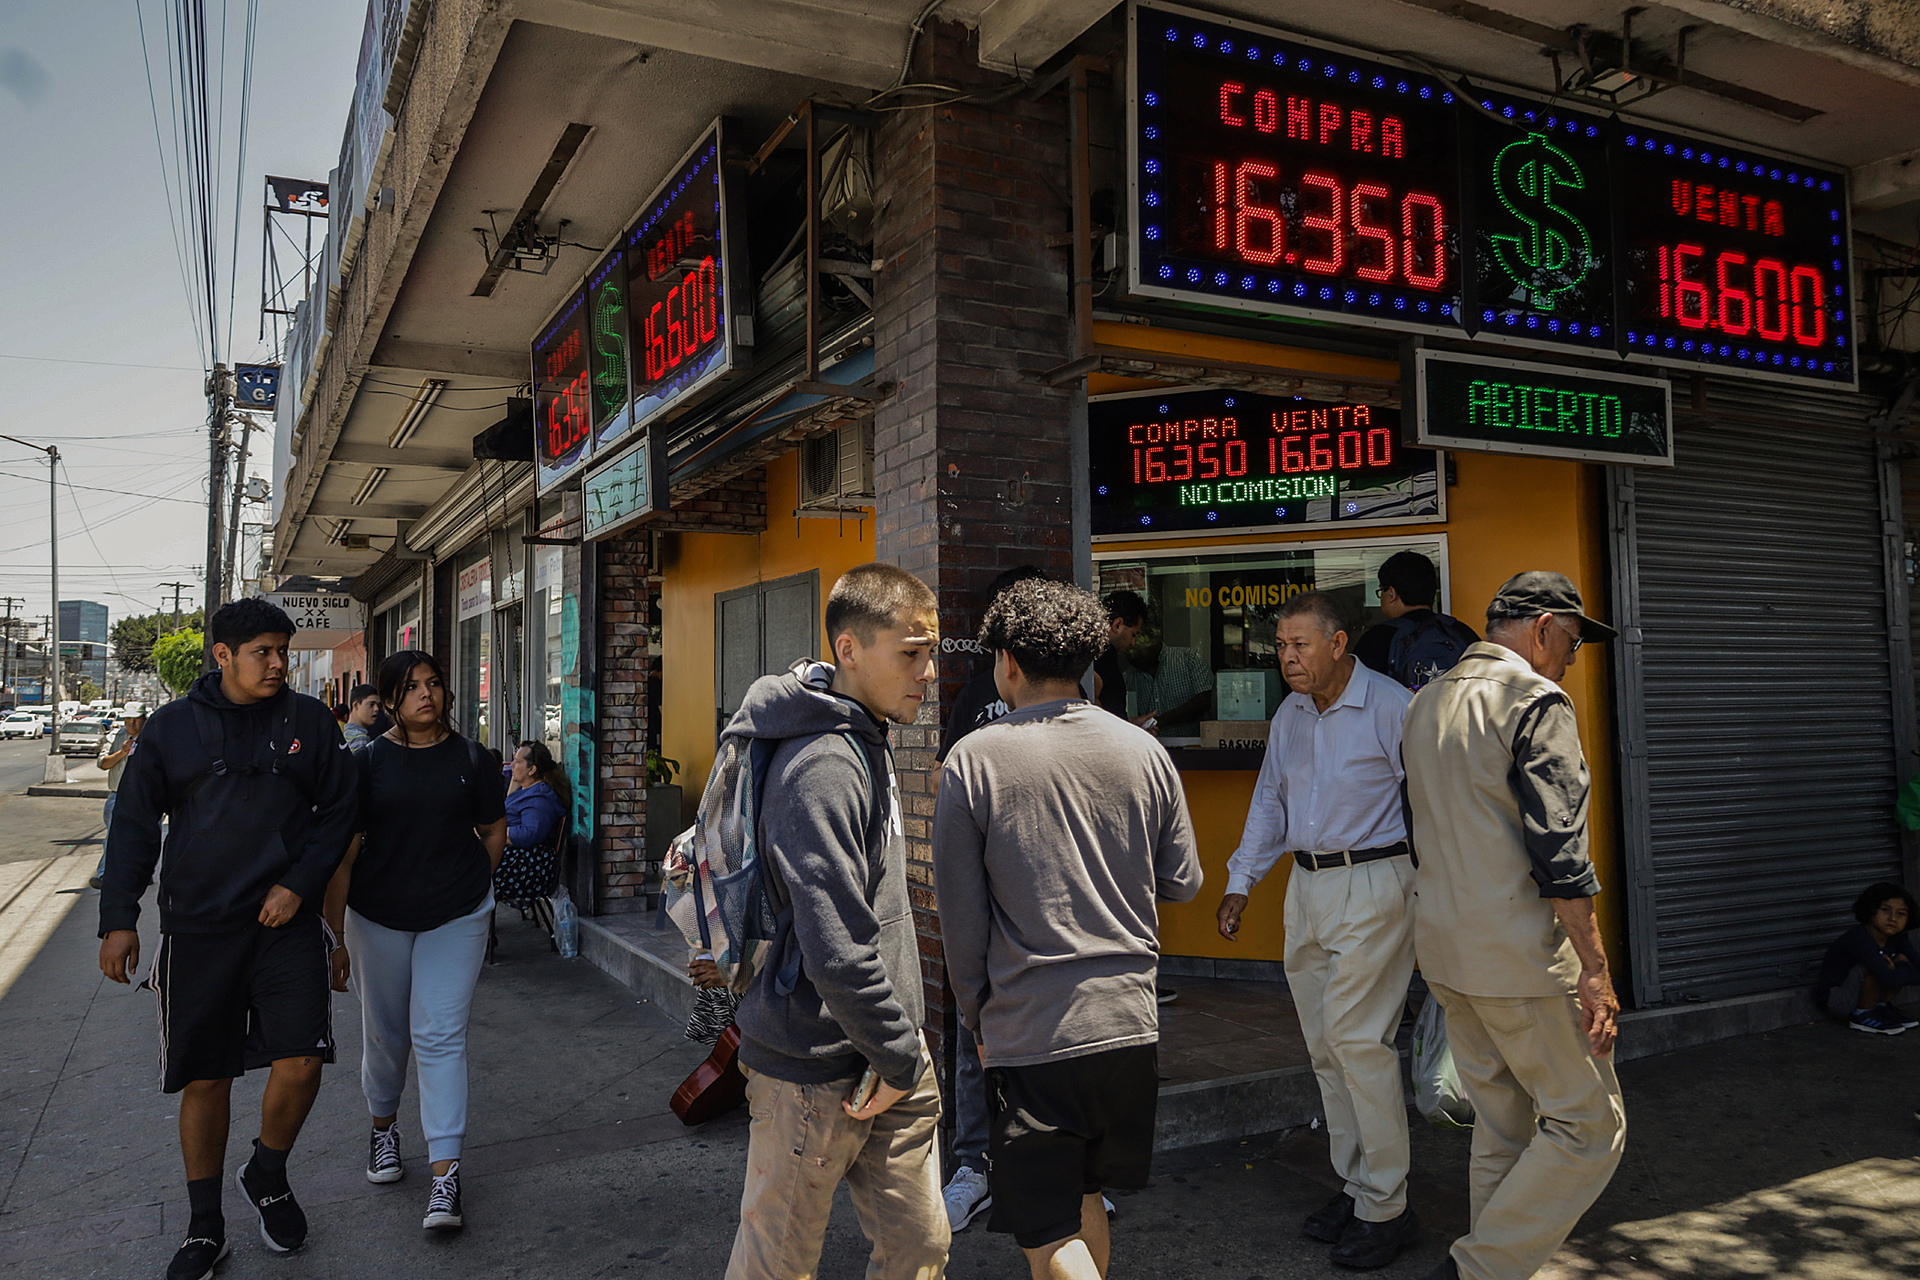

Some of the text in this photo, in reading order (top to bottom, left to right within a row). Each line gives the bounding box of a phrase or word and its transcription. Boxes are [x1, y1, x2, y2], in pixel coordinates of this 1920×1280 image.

[1220, 81, 1402, 158] COMPRA
[1215, 161, 1444, 288] 16.350
[1671, 178, 1784, 236] VENTA
[1658, 243, 1825, 347] 16.600
[1128, 404, 1369, 445] COMPRA VENTA
[1469, 380, 1621, 437] ABIERTO
[1133, 428, 1391, 484] 16.350 16.600
[1180, 475, 1335, 505] NO COMISION
[282, 597, 350, 608] NUEVO SIGLO
[1185, 587, 1212, 608] NO
[295, 618, 331, 629] CAFE
[1219, 739, 1266, 749] BASURA
